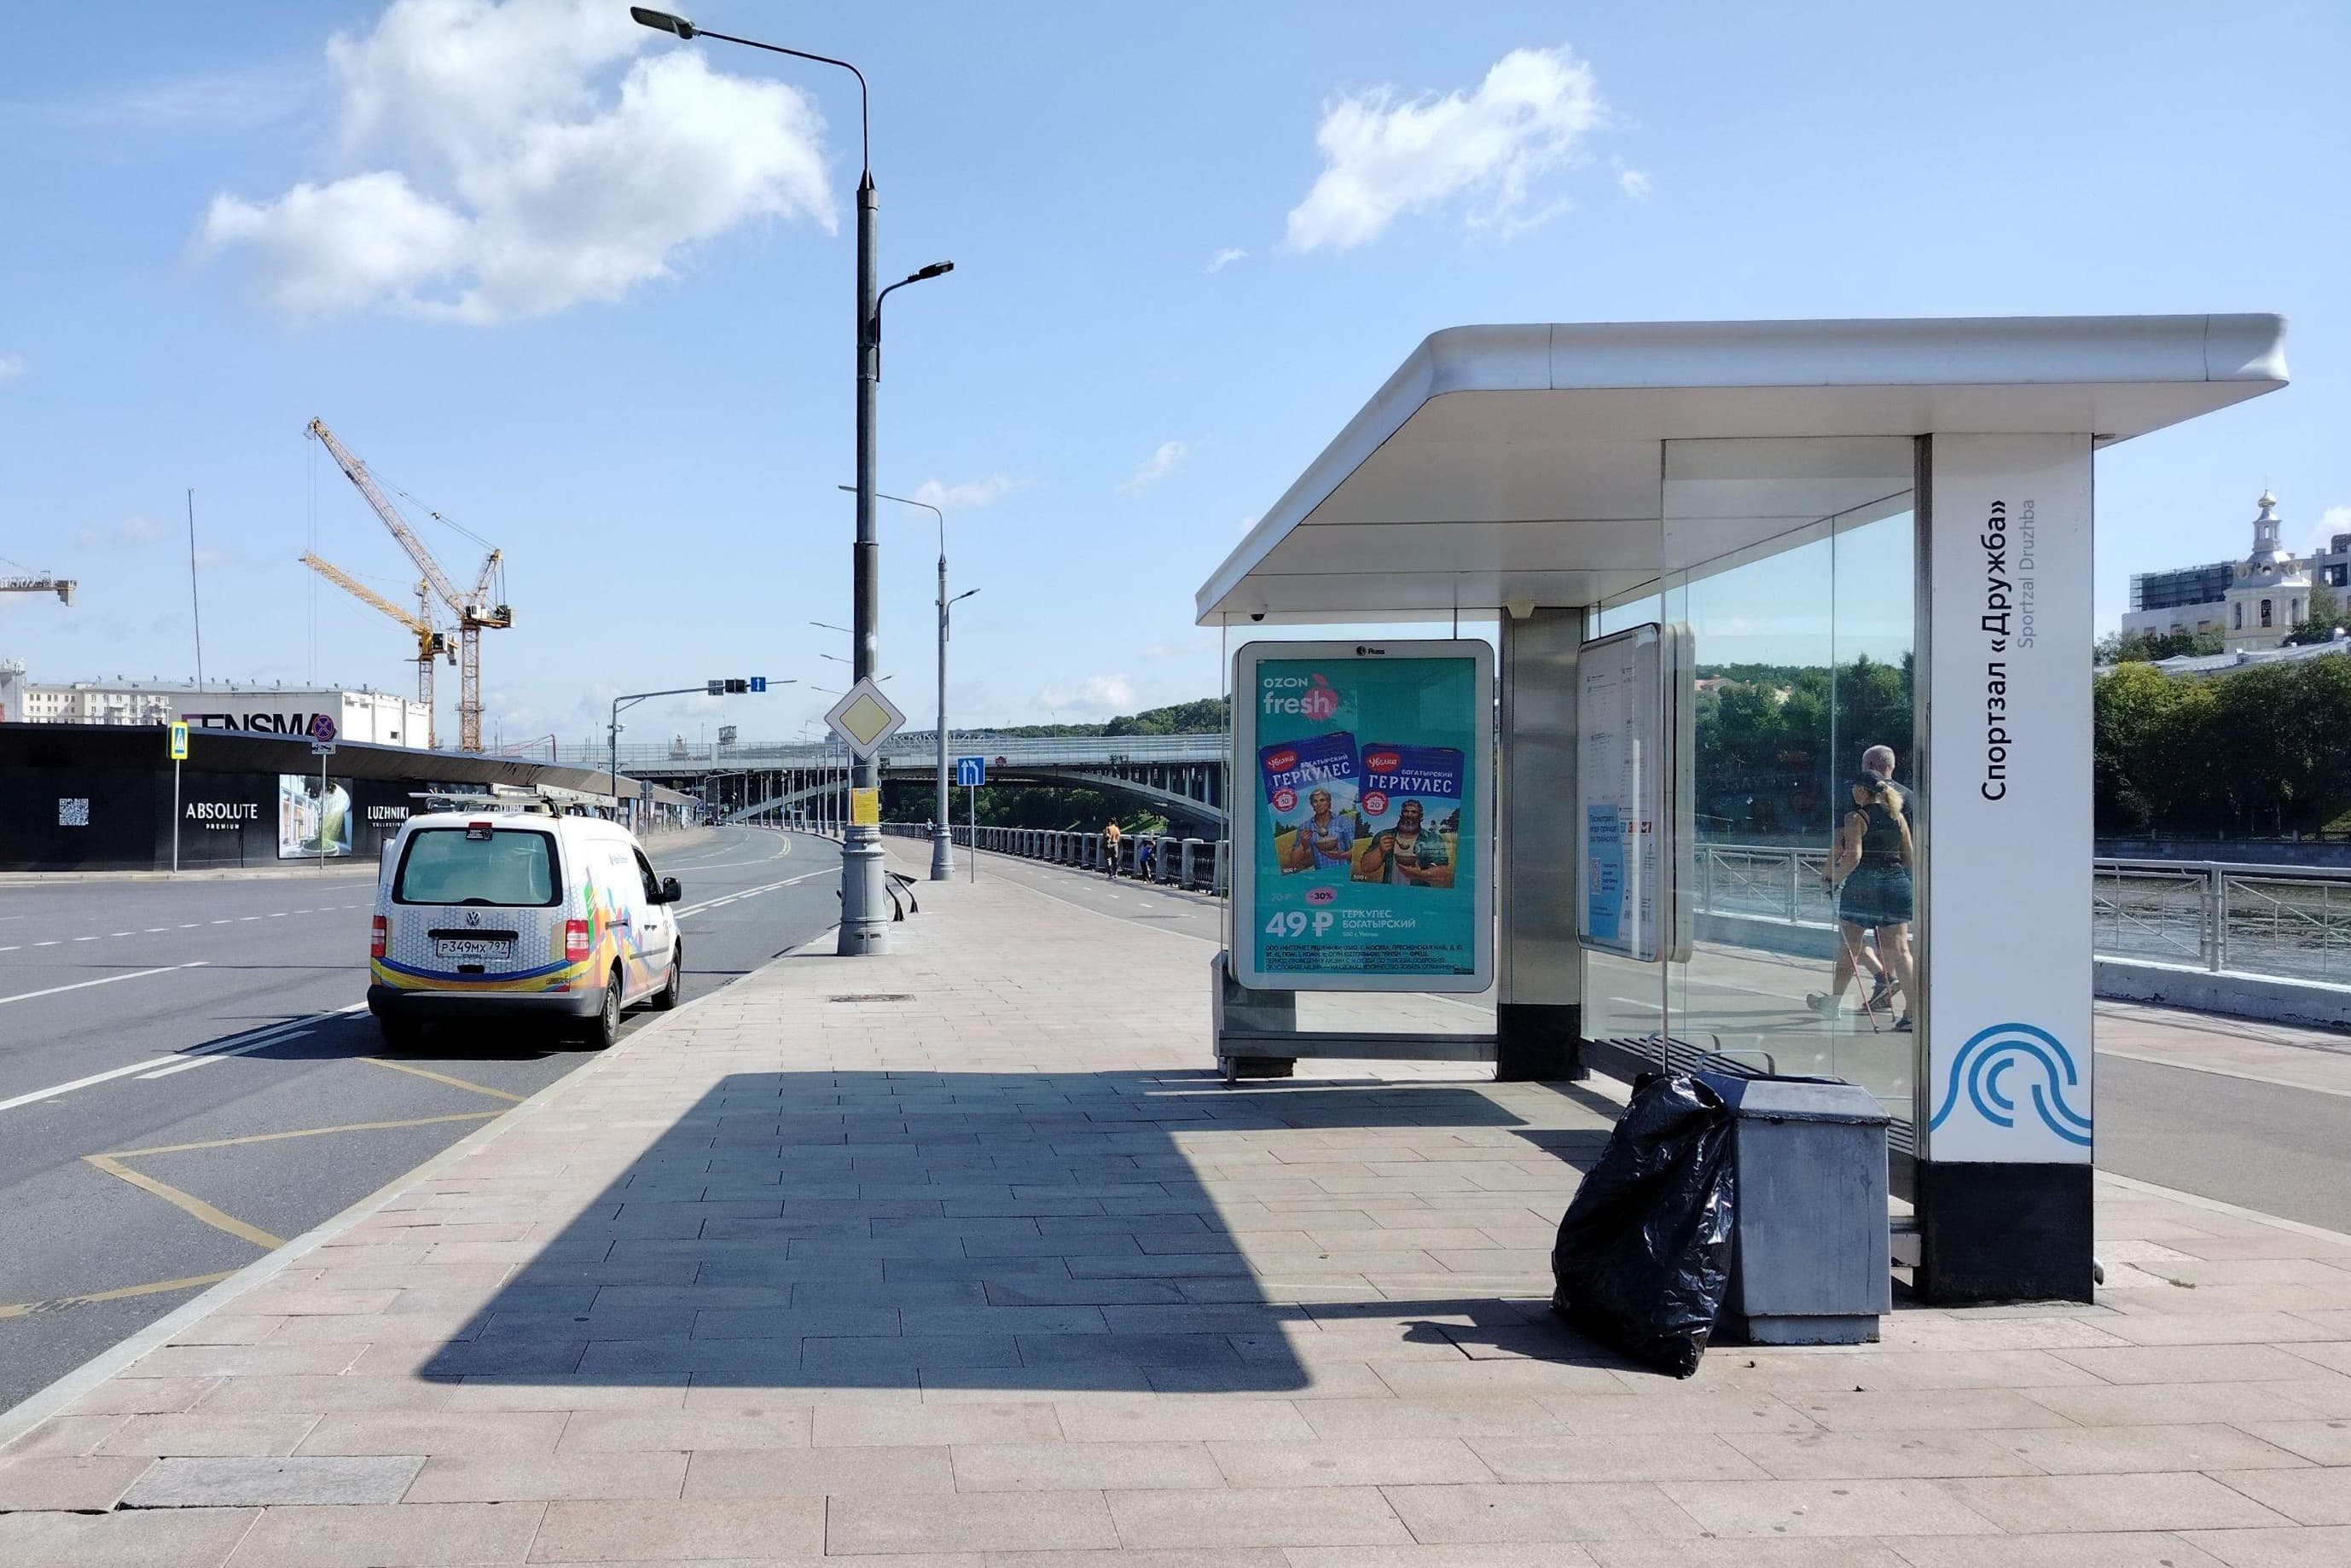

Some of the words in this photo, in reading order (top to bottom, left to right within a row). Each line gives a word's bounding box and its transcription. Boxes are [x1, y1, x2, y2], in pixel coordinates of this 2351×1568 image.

[2018, 500, 2035, 571] Druzhba
[1980, 500, 2012, 653] «Дружба»
[2017, 578, 2037, 648] Sportzal
[1263, 677, 1308, 688] OZON
[1263, 690, 1330, 714] fresh
[1981, 662, 2012, 801] Спортзал
[1272, 762, 1350, 787] ГЕРКУЛЕС
[1402, 769, 1453, 778] БОГАТЫРСКИЙ
[1368, 775, 1453, 793] ГЕРКУЛЕС
[185, 802, 258, 820] ABSOLUTE
[367, 805, 409, 820] LUZHNIKI
[1342, 909, 1392, 919] ГЕРКУЛЕС
[1265, 911, 1307, 938] 49
[1342, 919, 1416, 929] БОГАТЫРСКИЙ
[489, 941, 507, 951] 797
